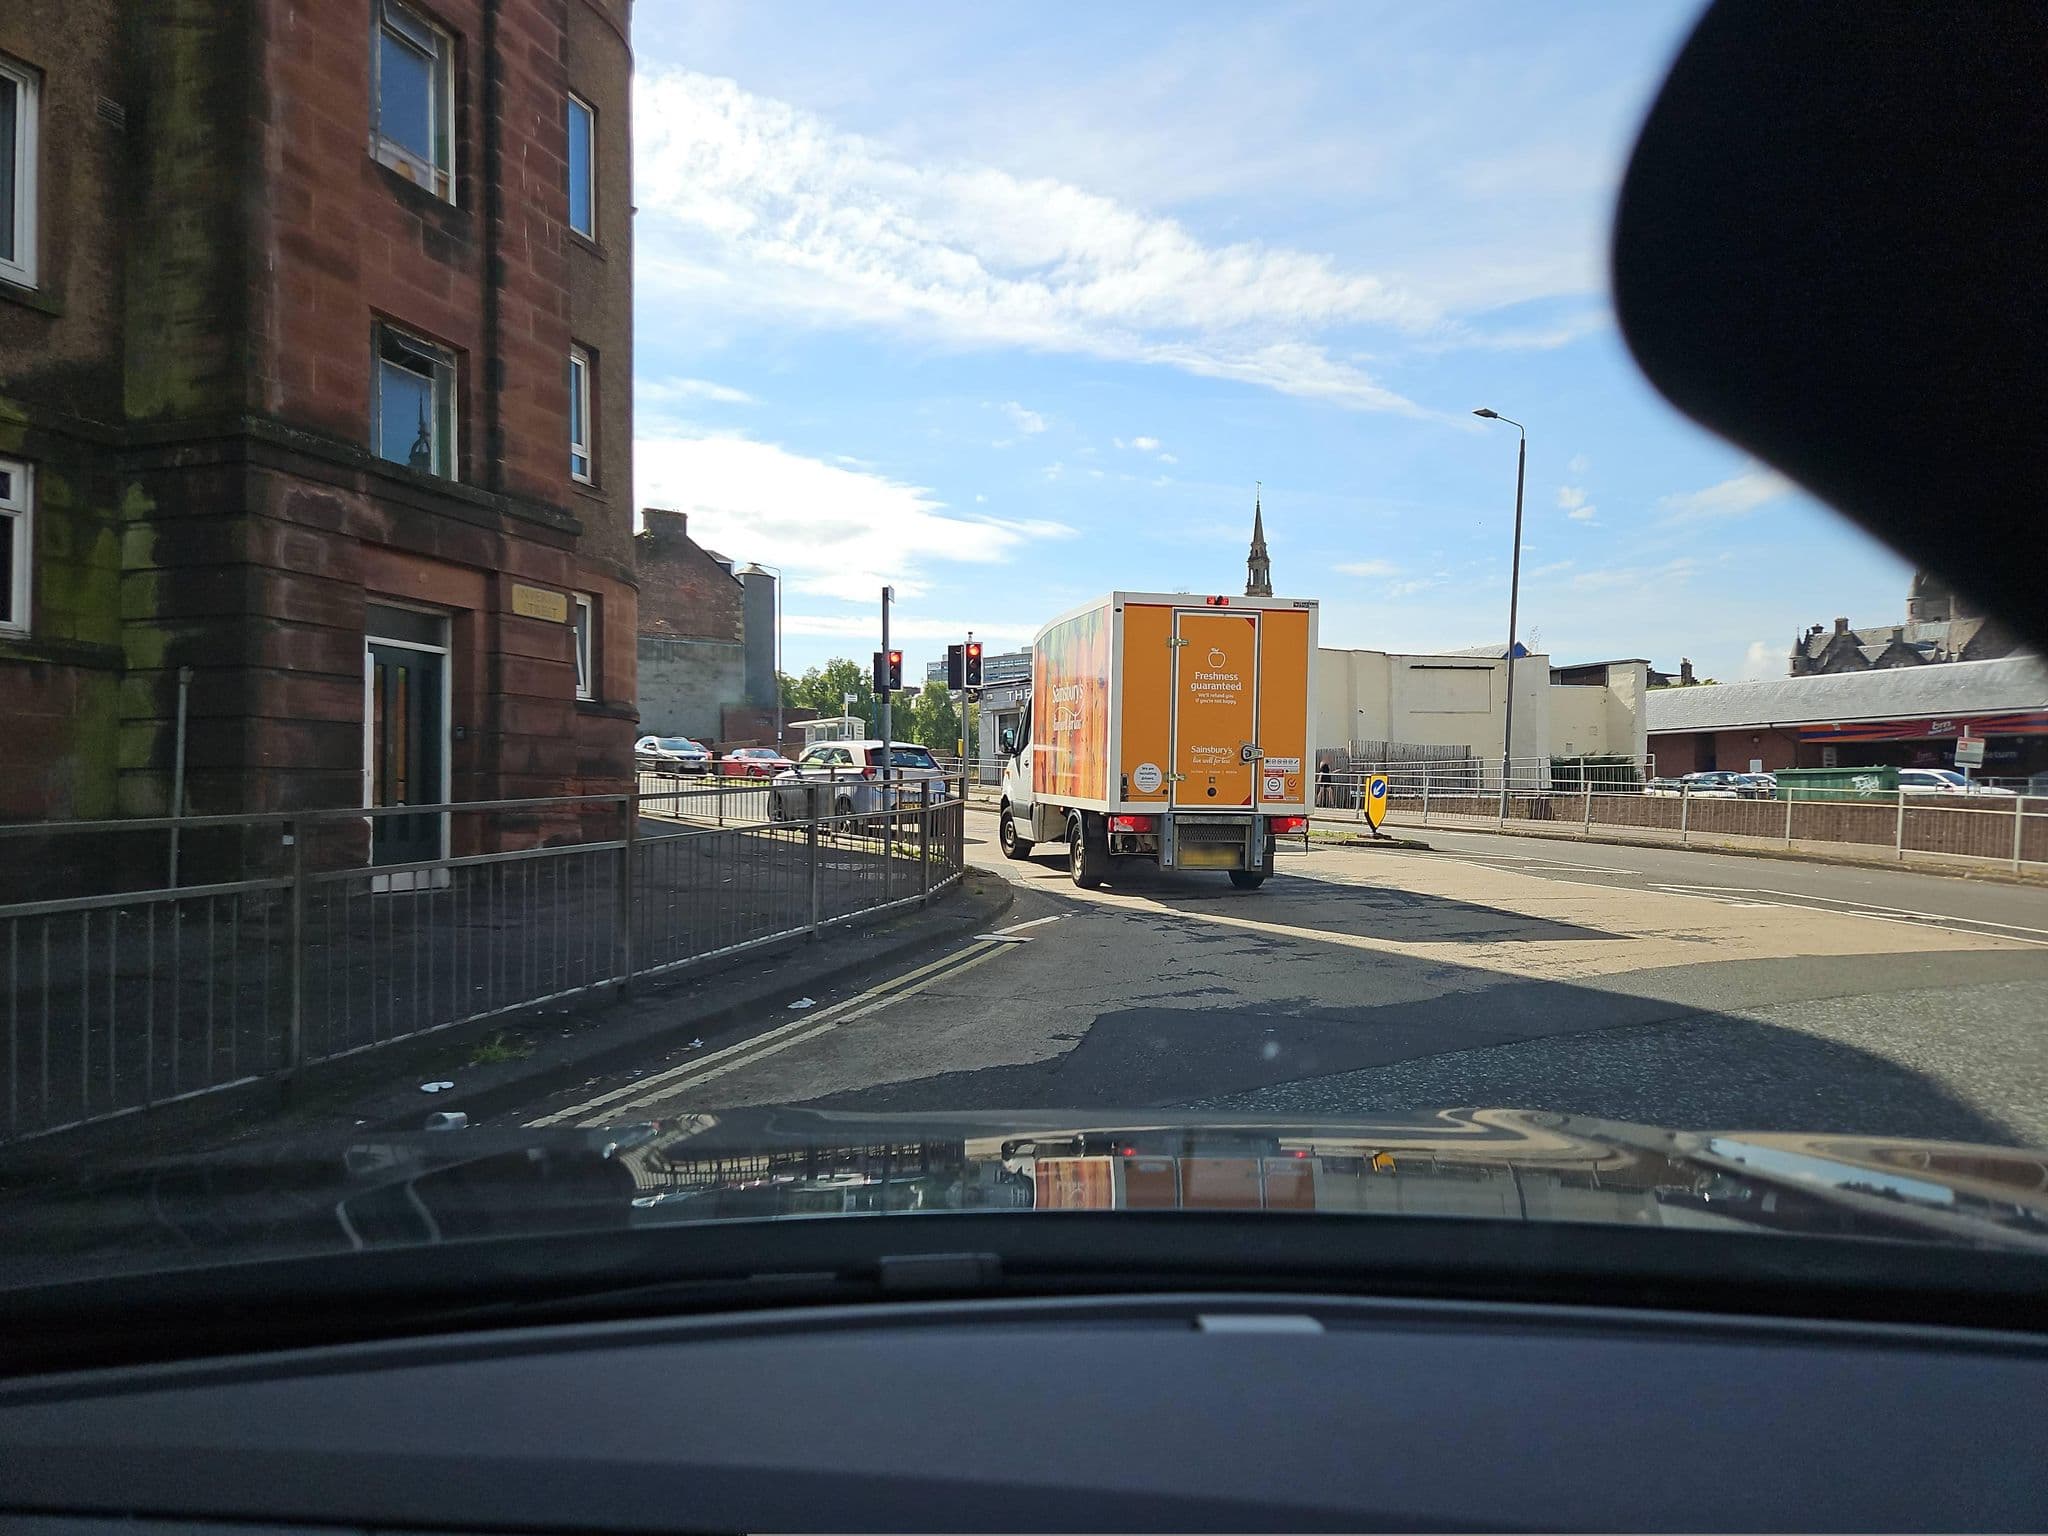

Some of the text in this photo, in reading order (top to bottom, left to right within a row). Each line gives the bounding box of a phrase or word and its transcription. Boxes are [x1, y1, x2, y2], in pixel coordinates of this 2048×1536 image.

[1195, 671, 1239, 681] Freshness
[1190, 682, 1242, 692] guaranteed
[1006, 688, 1032, 701] THE
[1053, 684, 1083, 704] Sainsbury's
[1190, 745, 1234, 756] Sainsbury's
